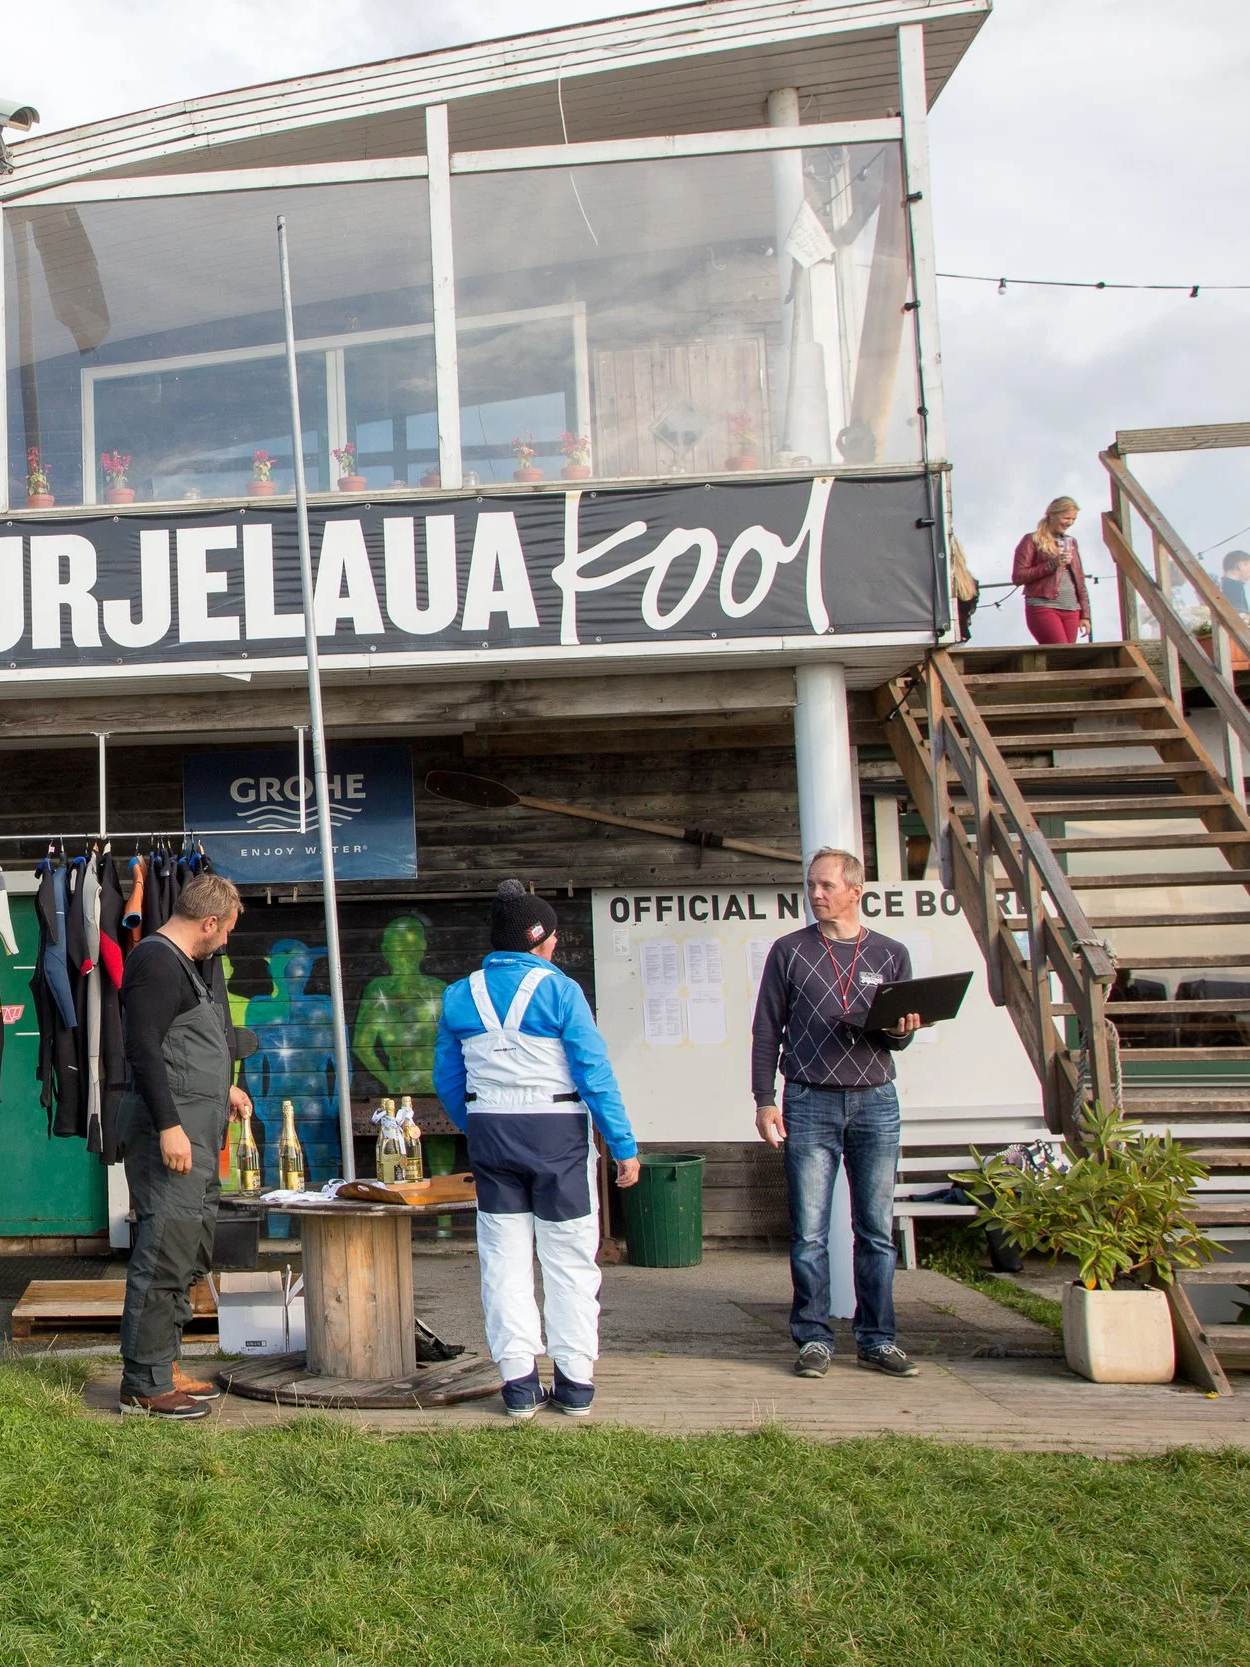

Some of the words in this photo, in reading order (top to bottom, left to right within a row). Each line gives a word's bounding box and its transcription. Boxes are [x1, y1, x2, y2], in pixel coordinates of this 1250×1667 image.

[240, 847, 295, 857] ENJOY
[305, 845, 362, 855] WTER
[610, 894, 767, 923] OFFICIAL
[777, 890, 905, 919] NCE
[915, 889, 1029, 918] BOR
